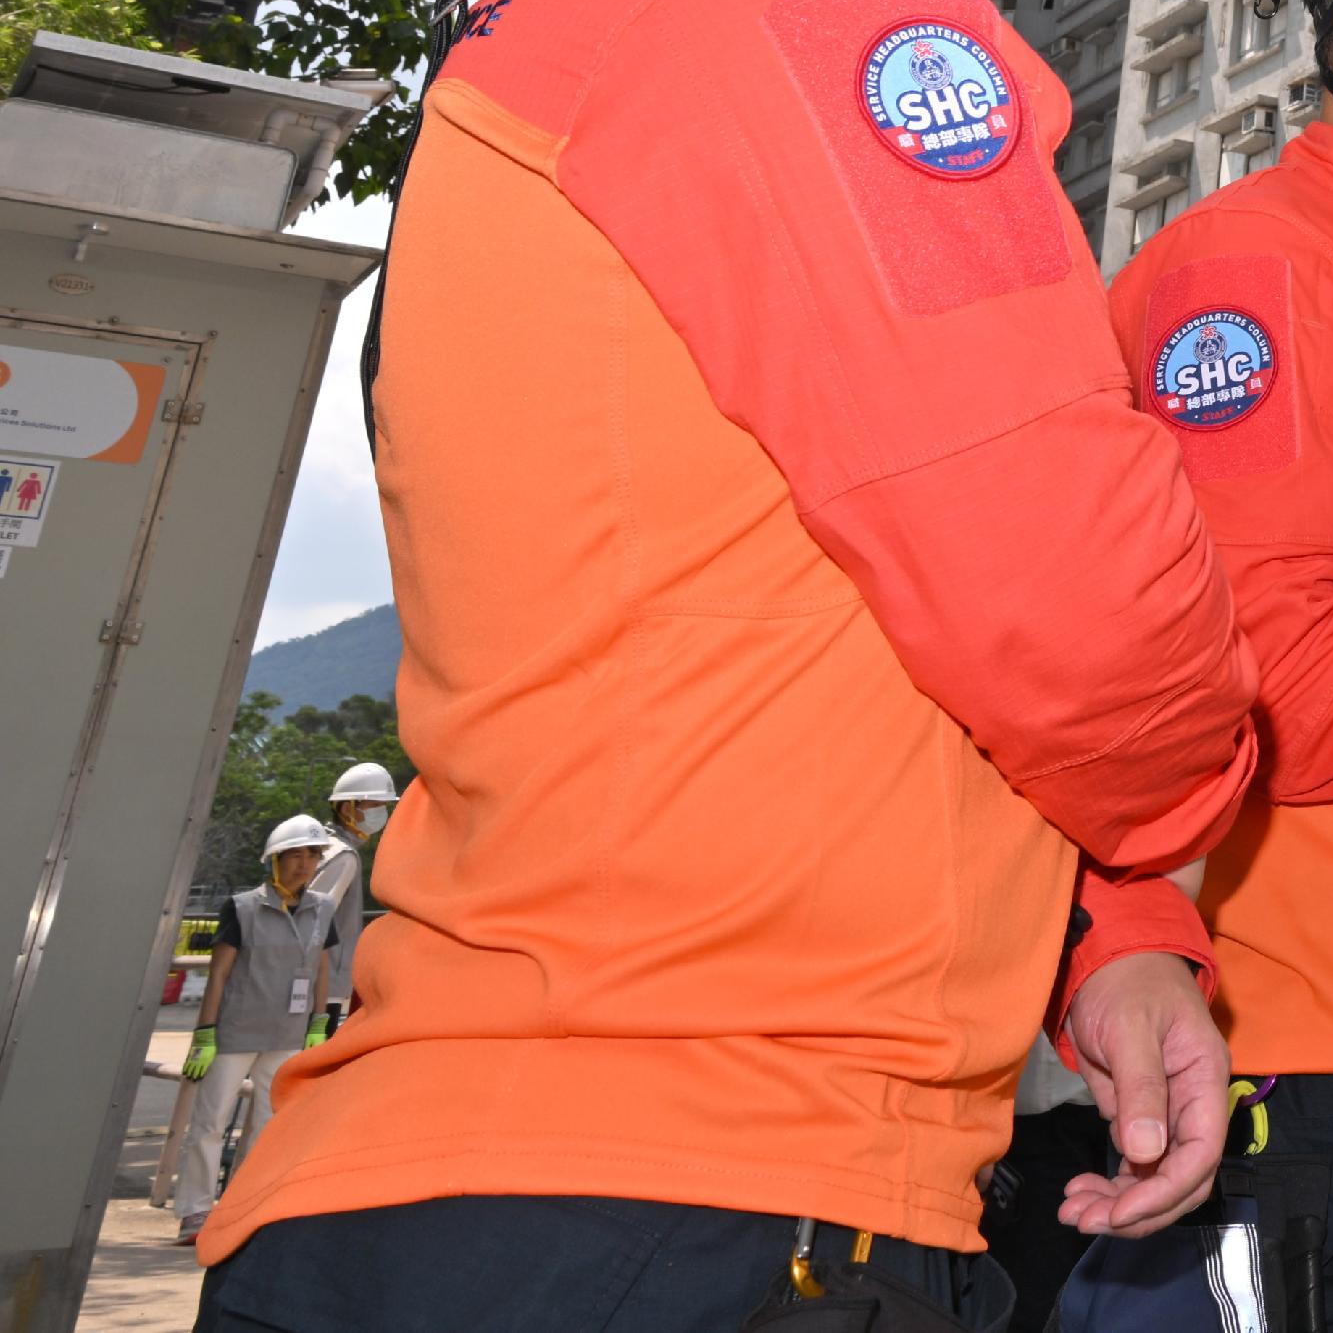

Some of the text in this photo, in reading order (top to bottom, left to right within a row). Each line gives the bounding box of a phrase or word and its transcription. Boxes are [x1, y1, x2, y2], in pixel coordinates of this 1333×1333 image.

[873, 25, 969, 63] HEADQUARTERS
[971, 45, 1007, 96] COLUMN
[866, 64, 887, 123] SERVICE
[899, 82, 989, 131] SHC
[921, 122, 991, 151] 總部專隊
[945, 150, 986, 166] STAFF
[1156, 347, 1171, 390] SERVICE
[1170, 312, 1247, 346] HEADQUARTERS
[1248, 323, 1271, 362] COLUMN
[1177, 354, 1252, 395] SHC
[1186, 385, 1246, 411] 總部專隊
[21, 420, 61, 431] Solutions
